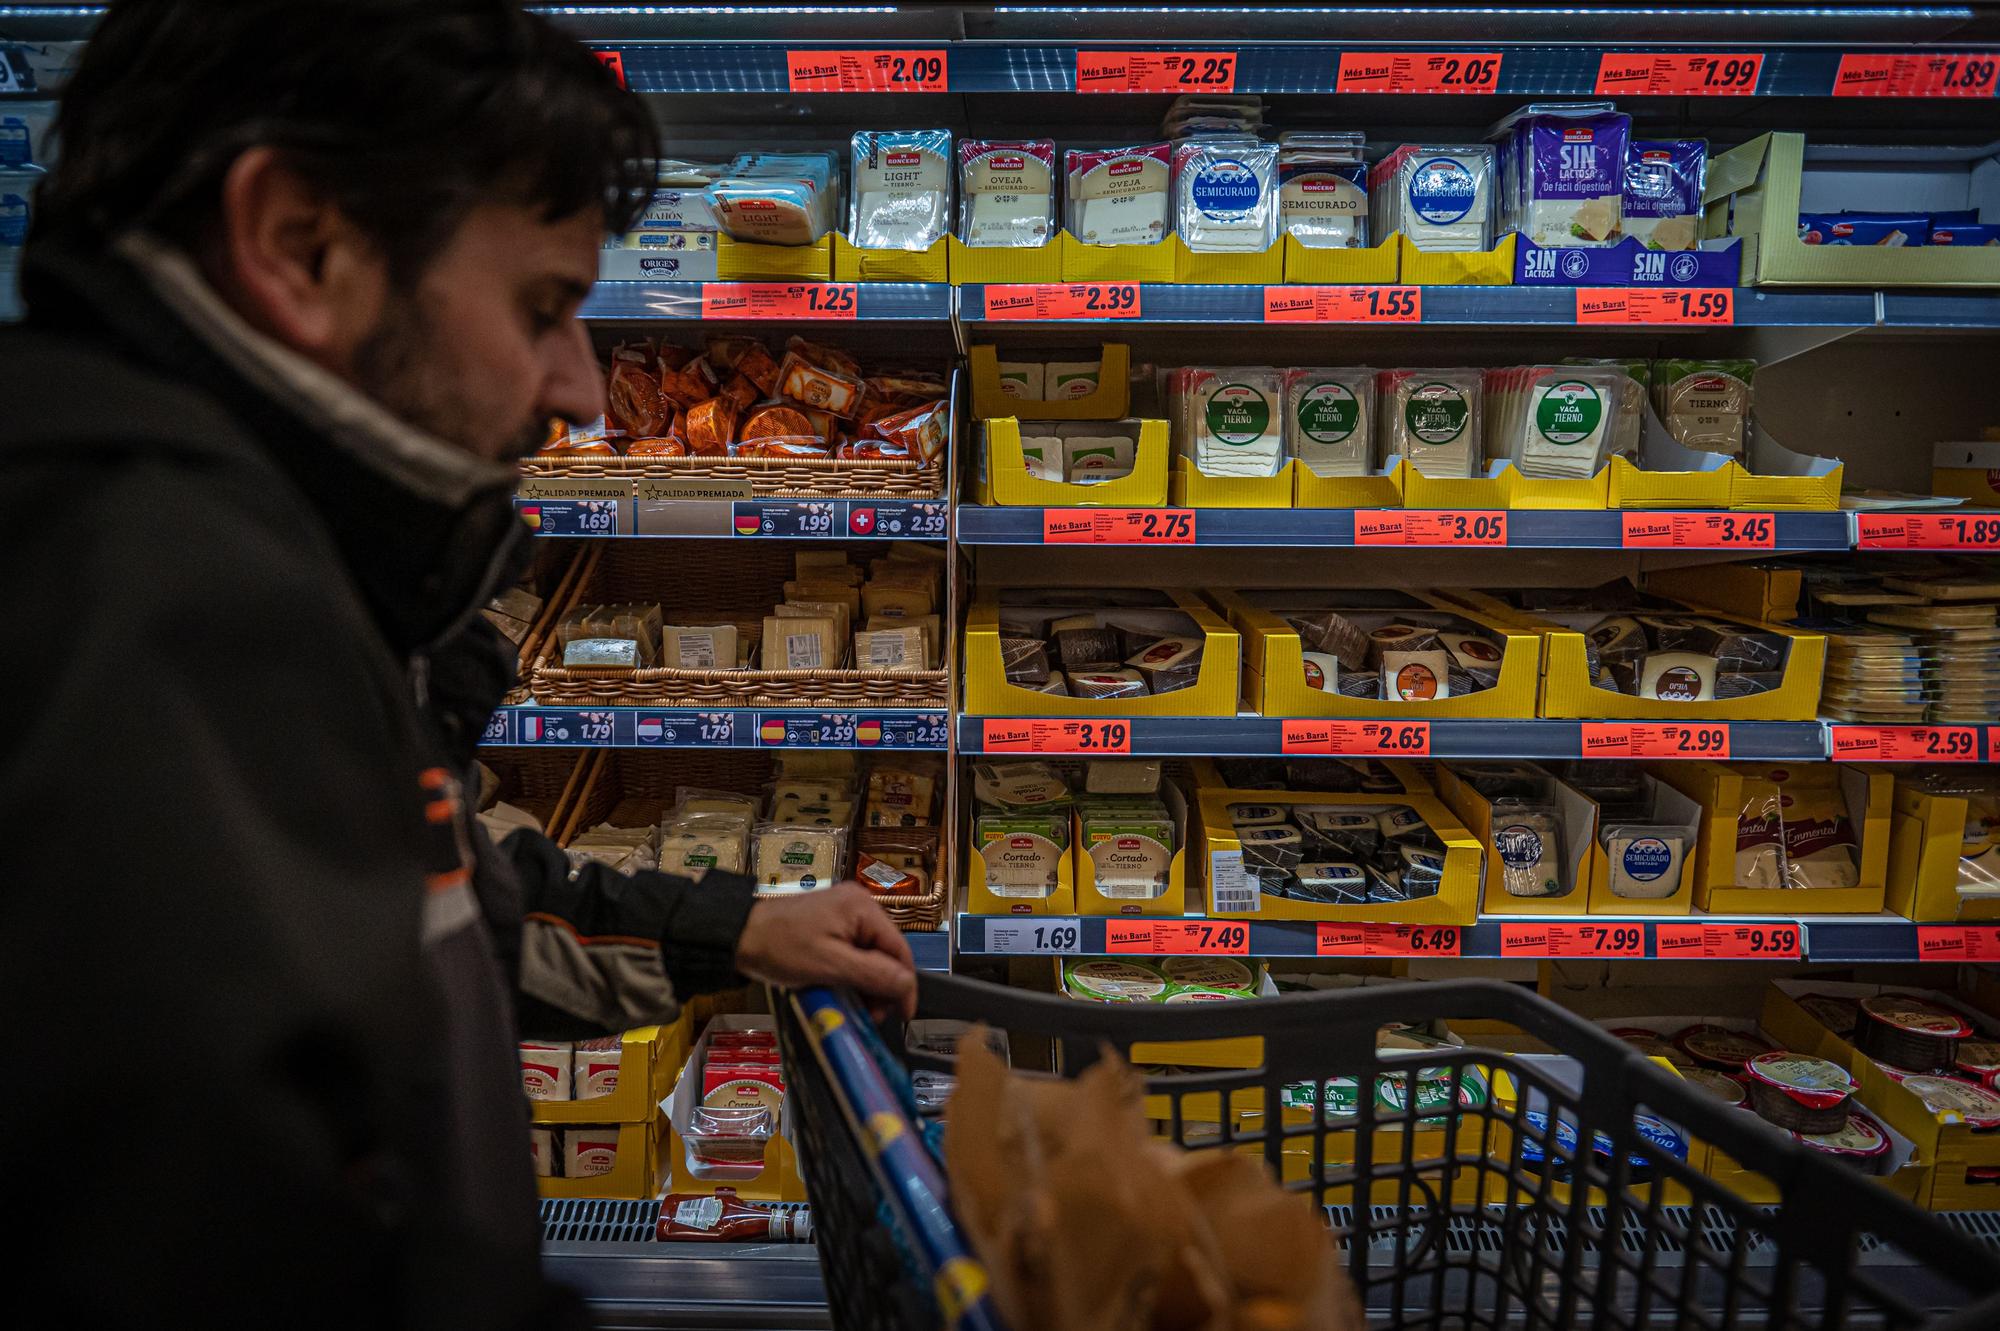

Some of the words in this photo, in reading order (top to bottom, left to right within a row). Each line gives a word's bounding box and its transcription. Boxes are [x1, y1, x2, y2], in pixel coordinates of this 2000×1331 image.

[795, 66, 812, 76] Més
[815, 65, 837, 75] Barat
[892, 57, 942, 82] 2.09
[1082, 68, 1099, 77] Més
[1101, 66, 1126, 75] Barat
[1179, 58, 1232, 84] 2.25
[1344, 68, 1362, 77] Més
[1364, 66, 1389, 76] Barat
[1441, 59, 1497, 85] 2.05
[1604, 69, 1623, 79] Més
[1625, 67, 1649, 78] Barat
[1703, 59, 1755, 87] 1.99
[1943, 60, 1995, 87] 1.89
[887, 157, 920, 165] RONCERO
[1560, 145, 1595, 169] SIN
[991, 161, 1023, 169] RONCERO
[1110, 165, 1142, 175] RONCERO
[884, 172, 920, 181] LIGHT
[990, 176, 1023, 184] OVEJA
[1109, 178, 1141, 188] OVEJA
[1543, 183, 1554, 192] De
[1555, 182, 1572, 192] fácil
[1195, 187, 1257, 197] SEMICURADO
[1281, 200, 1357, 210] SEMICURADO
[643, 259, 676, 268] ORIGEN
[1525, 250, 1556, 270] SIN
[1633, 253, 1666, 273] SIN
[1525, 270, 1555, 278] LACTOSA
[1633, 273, 1664, 281] LACTOSA
[807, 287, 856, 312] 1.25
[990, 298, 1007, 307] Més
[1009, 296, 1033, 305] Barat
[1086, 287, 1136, 310] 2.39
[1270, 300, 1287, 309] Més
[1289, 299, 1313, 308] Barat
[1367, 290, 1416, 316] 1.55
[1582, 302, 1602, 311] Més
[1603, 300, 1625, 310] Barat
[1679, 293, 1728, 318] 1.59
[1689, 399, 1729, 408] TIERNO
[1223, 415, 1252, 424] TIERNO
[1314, 413, 1343, 422] TIERNO
[1554, 413, 1584, 423] TIERNO
[539, 488, 576, 497] CALIDAD
[578, 489, 625, 497] PREMIADA
[658, 488, 695, 497] CALIDAD
[697, 489, 744, 498] PREMIADA
[578, 513, 610, 529] 1.69
[799, 515, 831, 531] 1.99
[911, 515, 945, 531] 2.59
[1049, 522, 1067, 531] Més
[1069, 520, 1091, 530] Barat
[1142, 514, 1192, 538] 2.75
[1360, 524, 1377, 533] Més
[1380, 522, 1402, 532] Barat
[1453, 516, 1503, 540] 3.05
[1628, 525, 1645, 535] Més
[1648, 524, 1670, 533] Barat
[1721, 518, 1770, 542] 3.45
[1882, 526, 1905, 536] Barat
[1956, 520, 2000, 543] 1.89
[481, 723, 504, 738] .89
[580, 723, 611, 739] 1.79
[699, 724, 730, 740] 1.79
[820, 726, 854, 742] 2.59
[916, 726, 948, 743] 2.59
[988, 732, 1006, 741] Més
[1007, 730, 1029, 740] Barat
[1079, 724, 1126, 748] 3.19
[1287, 732, 1304, 741] Més
[1307, 731, 1328, 740] Barat
[1378, 726, 1426, 750] 2.65
[1587, 737, 1604, 745] Més
[1606, 735, 1628, 745] Barat
[1678, 729, 1724, 751] 2.99
[1837, 740, 1854, 749] Més
[1856, 738, 1877, 748] Barat
[1926, 732, 1972, 755] 2.59
[1785, 817, 1839, 845] Emmental
[1003, 852, 1041, 862] Cortado
[1110, 853, 1148, 862] Cortado
[1625, 854, 1670, 863] SEMICURADO
[1034, 927, 1077, 949] 1.69
[1111, 933, 1128, 941] Més
[1130, 931, 1151, 940] Barat
[1200, 927, 1244, 949] 7.49
[1322, 935, 1339, 944] Més
[1341, 933, 1363, 943] Barat
[1411, 928, 1456, 950] 6.49
[1506, 936, 1524, 945] Més
[1526, 934, 1547, 944] Barat
[1594, 928, 1640, 951] 7.99
[1662, 937, 1678, 946] Més
[1680, 936, 1702, 945] Barat
[1750, 930, 1795, 952] 9.59
[527, 1087, 548, 1095] RADO
